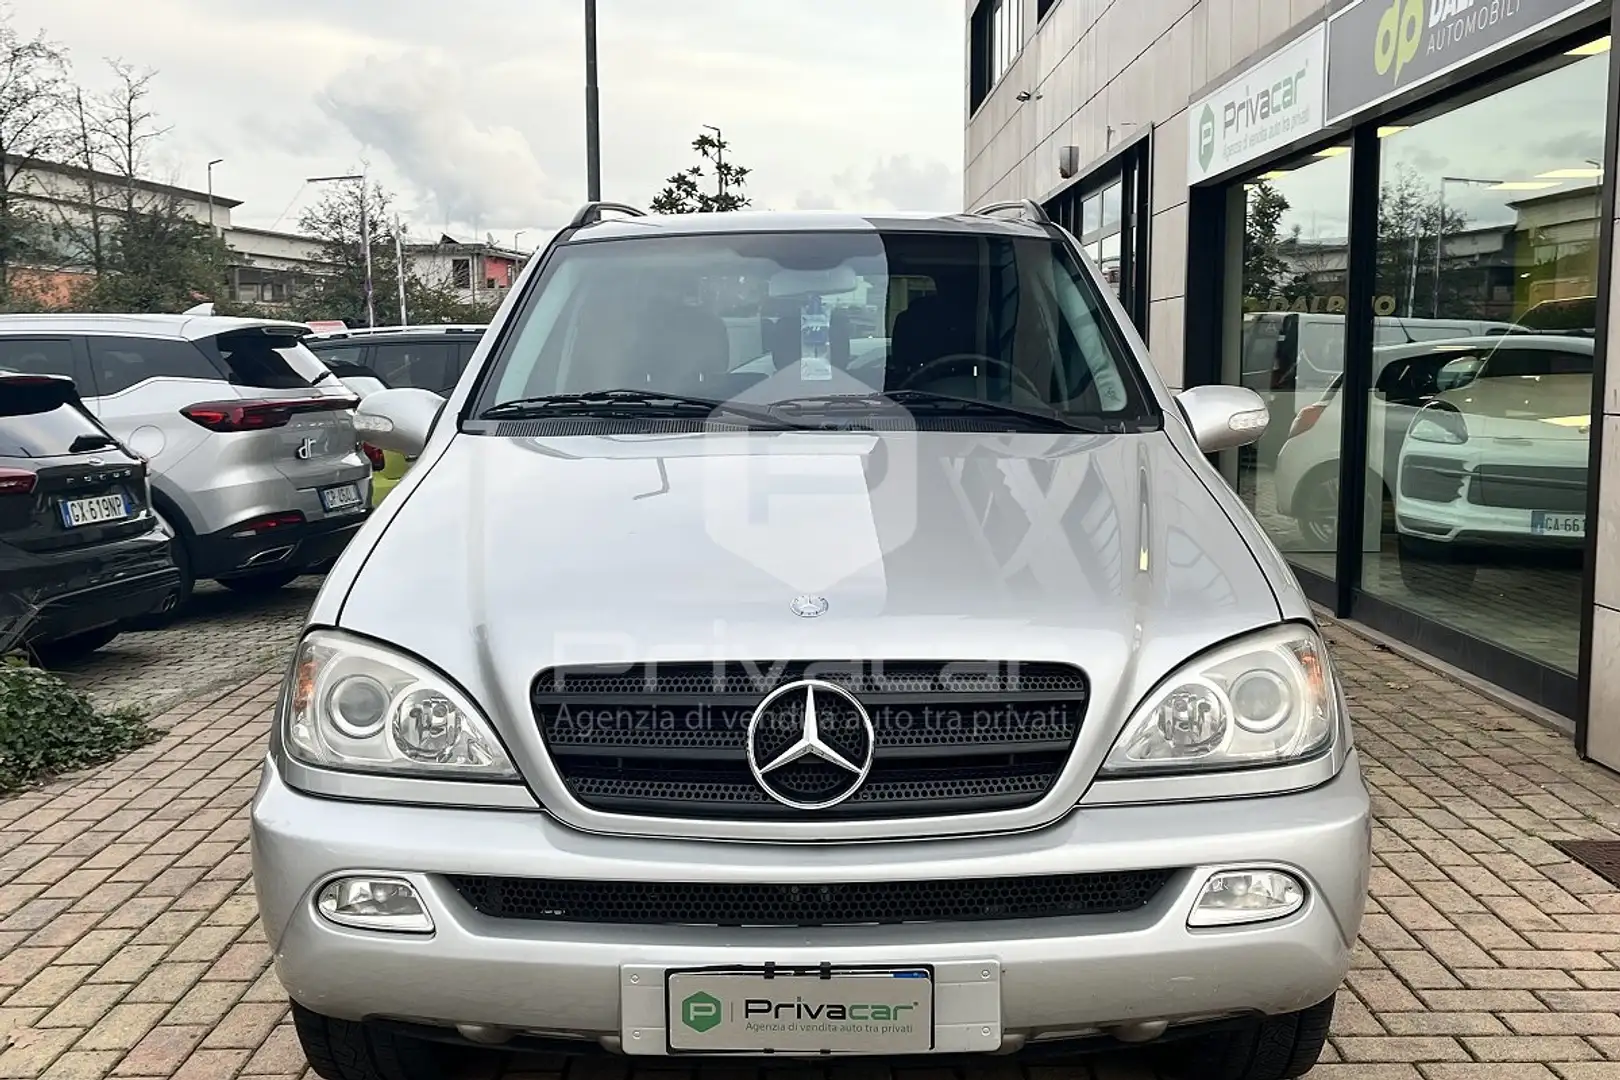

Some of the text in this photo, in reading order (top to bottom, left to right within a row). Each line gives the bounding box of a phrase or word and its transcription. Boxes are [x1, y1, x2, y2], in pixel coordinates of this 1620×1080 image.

[1223, 68, 1307, 139] Privacar
[745, 997, 914, 1020] Privacar
[745, 1022, 913, 1034] Agenzia di vendita auto tra privati
